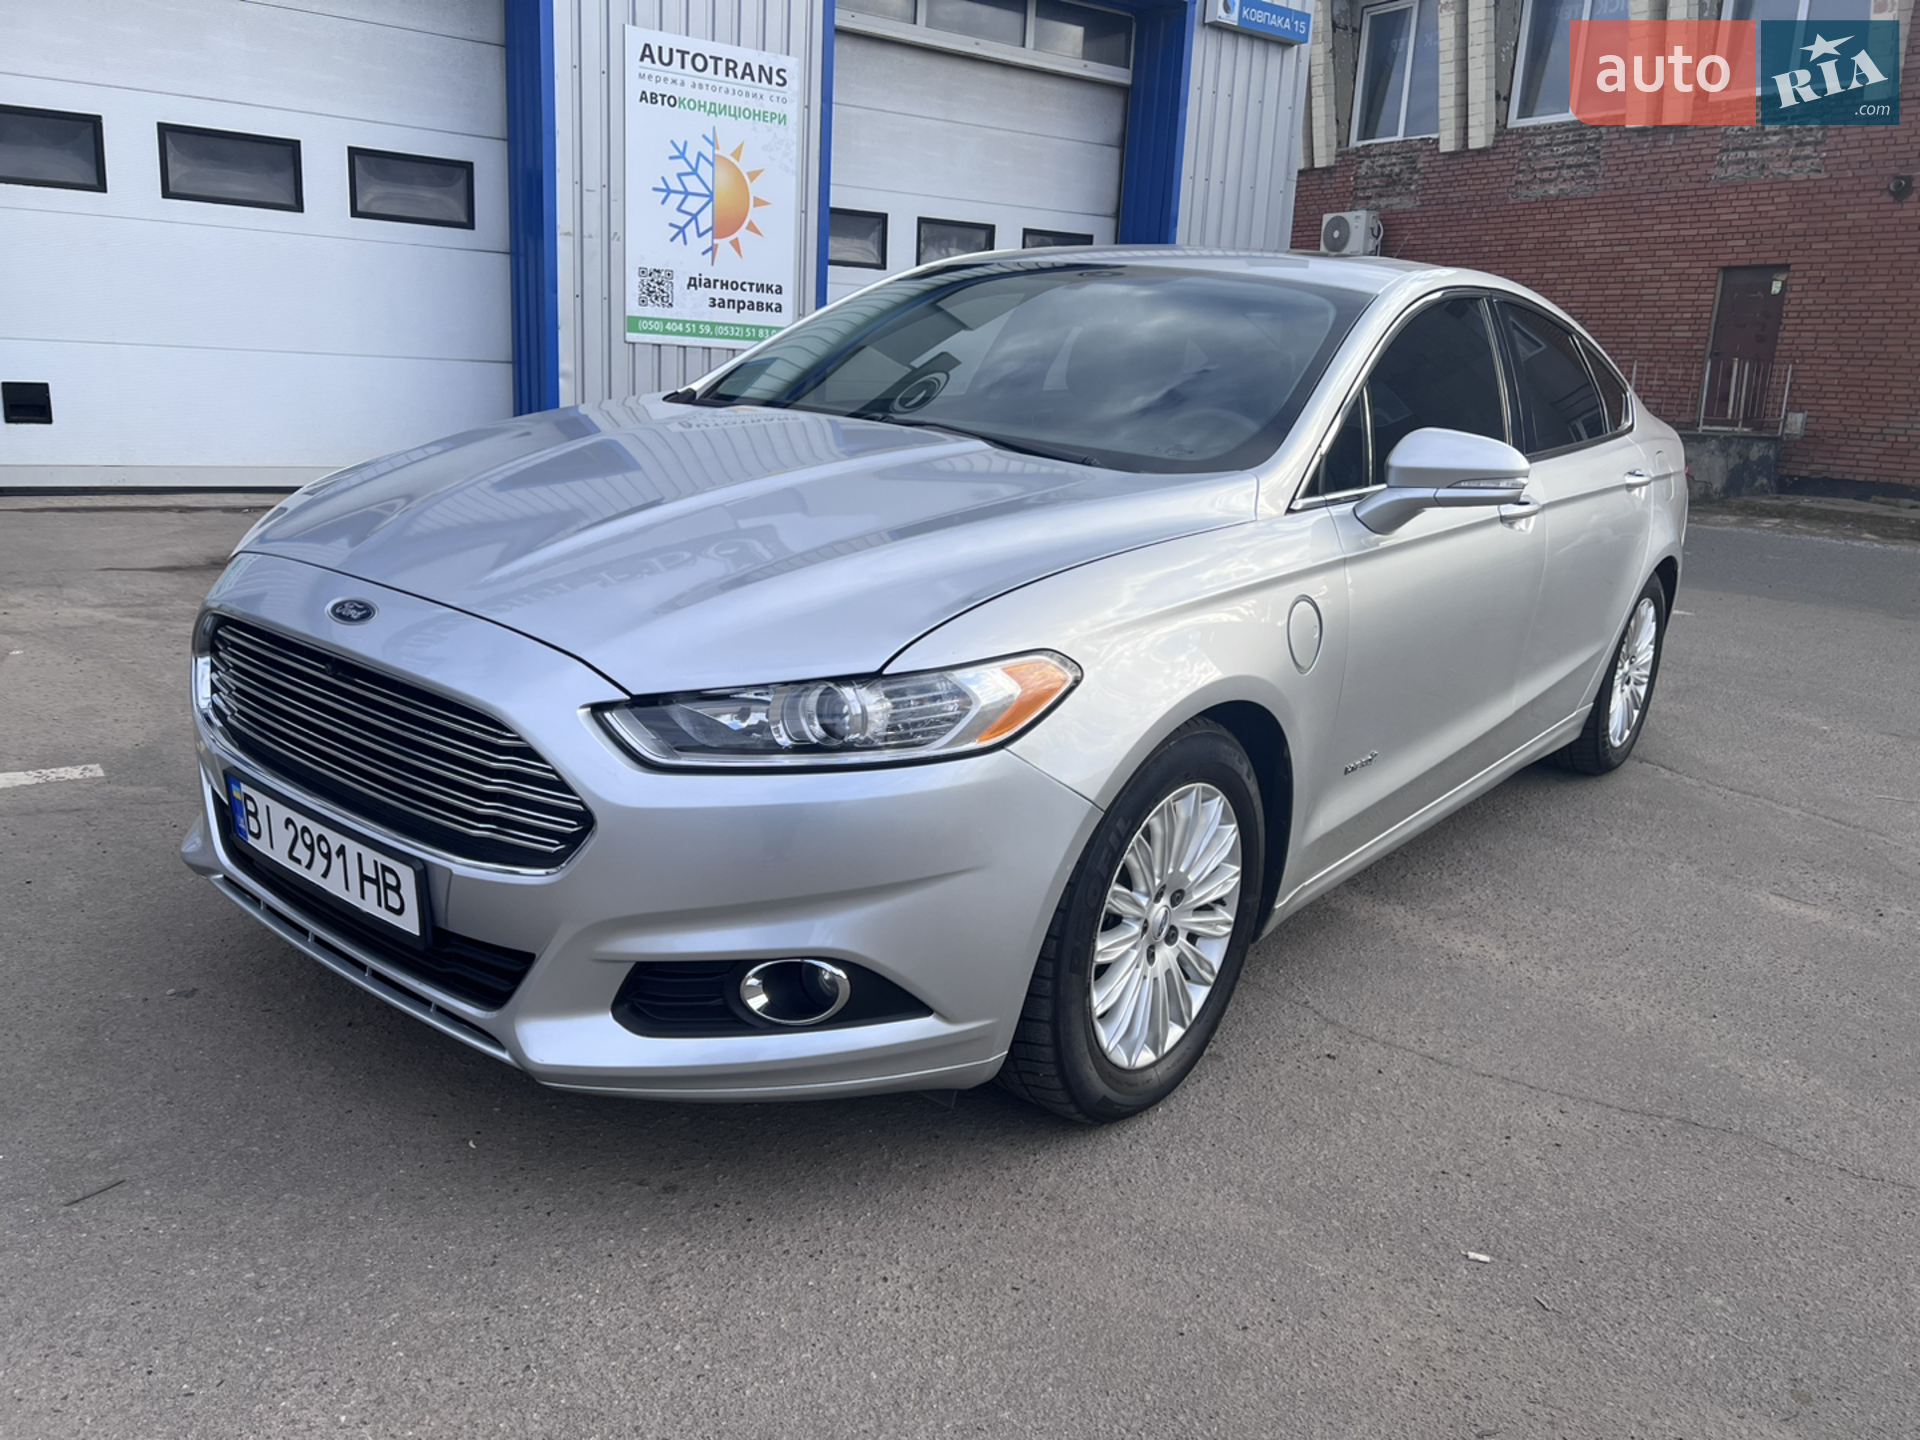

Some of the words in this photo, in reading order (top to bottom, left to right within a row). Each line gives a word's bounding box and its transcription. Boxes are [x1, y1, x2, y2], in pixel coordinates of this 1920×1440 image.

[1242, 6, 1291, 30] КОВПАКА
[1292, 20, 1306, 34] 15
[638, 42, 788, 87] AUTOTRANS
[638, 72, 686, 87] мережа
[690, 81, 765, 101] автогазових
[638, 90, 788, 126] АВТОКОНДИЦІОНЕРИ
[686, 272, 783, 296] діагностика
[708, 296, 783, 314] заправка
[638, 319, 664, 333] (050)
[665, 322, 683, 333] 404
[685, 323, 696, 333] 51
[714, 325, 745, 338] (0532)
[745, 327, 756, 338] 51
[284, 816, 350, 893] 2991
[357, 851, 406, 917] HB
